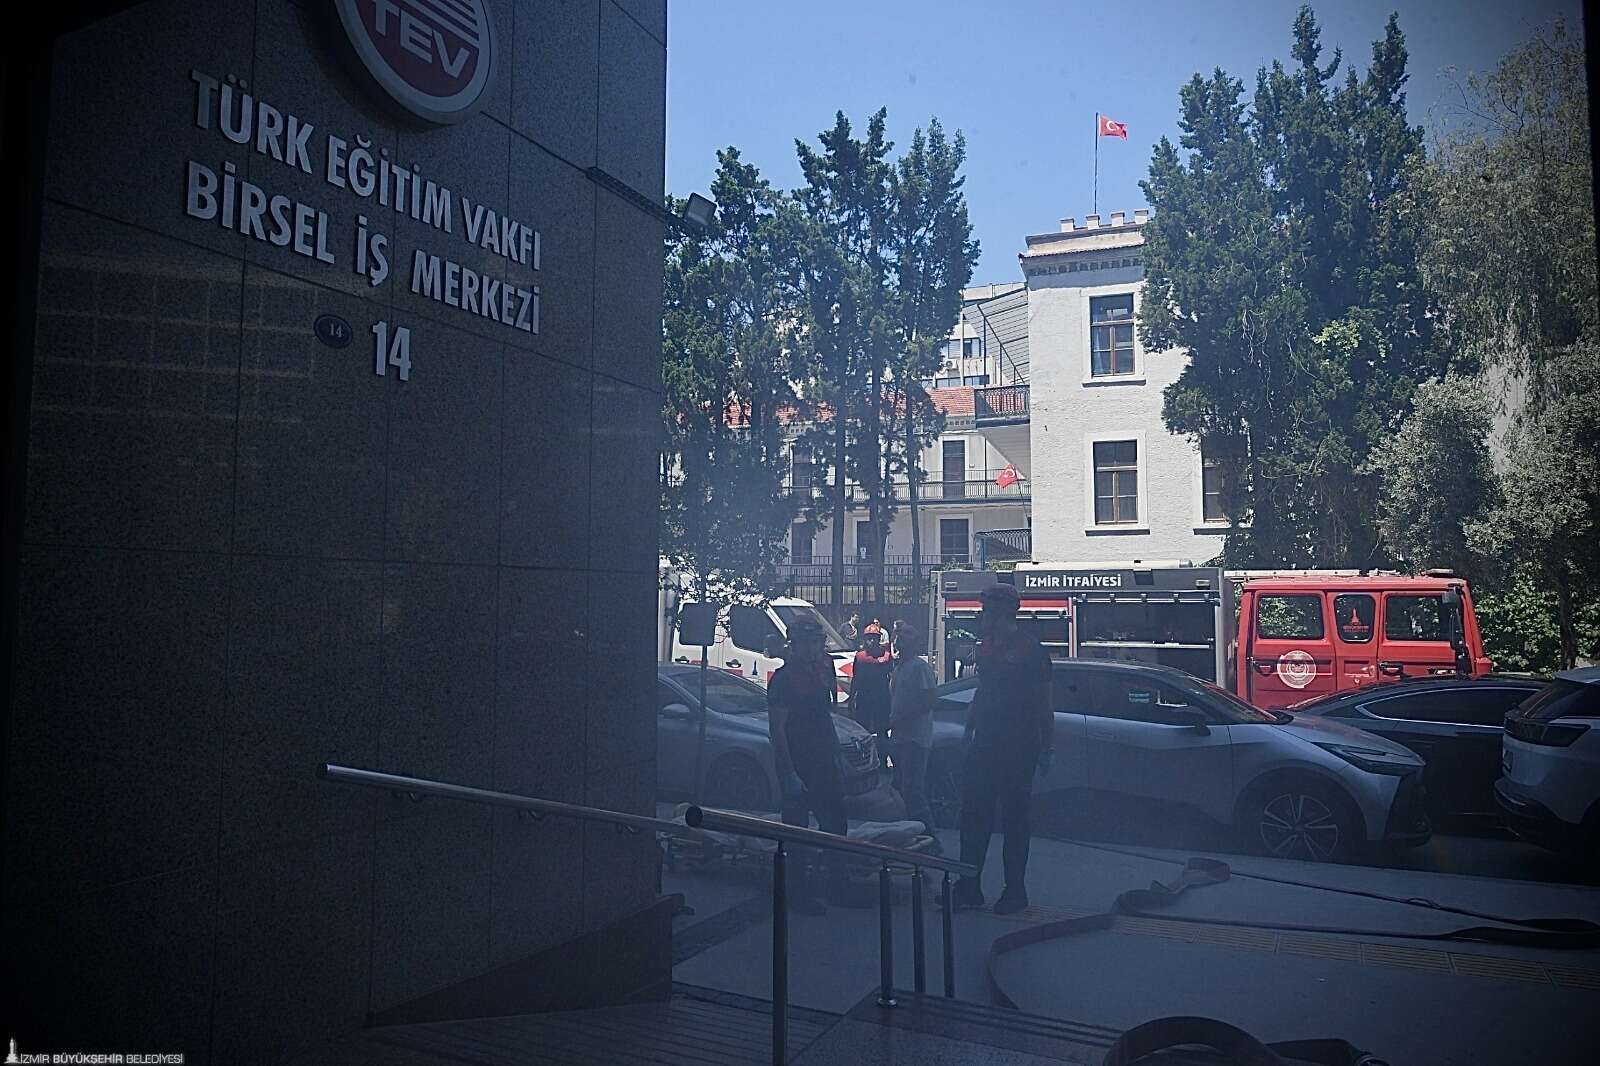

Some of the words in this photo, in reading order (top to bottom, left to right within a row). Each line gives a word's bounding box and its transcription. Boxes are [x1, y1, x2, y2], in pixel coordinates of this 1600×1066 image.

[370, 0, 470, 79] TEV
[189, 69, 315, 175] TÜRK
[327, 134, 452, 233] EĞİTİM
[461, 197, 541, 271] VAKFI
[185, 160, 336, 264] BİRSEL
[355, 214, 389, 287] İŞ
[410, 250, 541, 335] MERKEZİ
[330, 322, 345, 338] 14
[372, 321, 412, 382] 14
[1025, 574, 1060, 587] İZMİR
[1062, 573, 1122, 587] İTFAİYESİ
